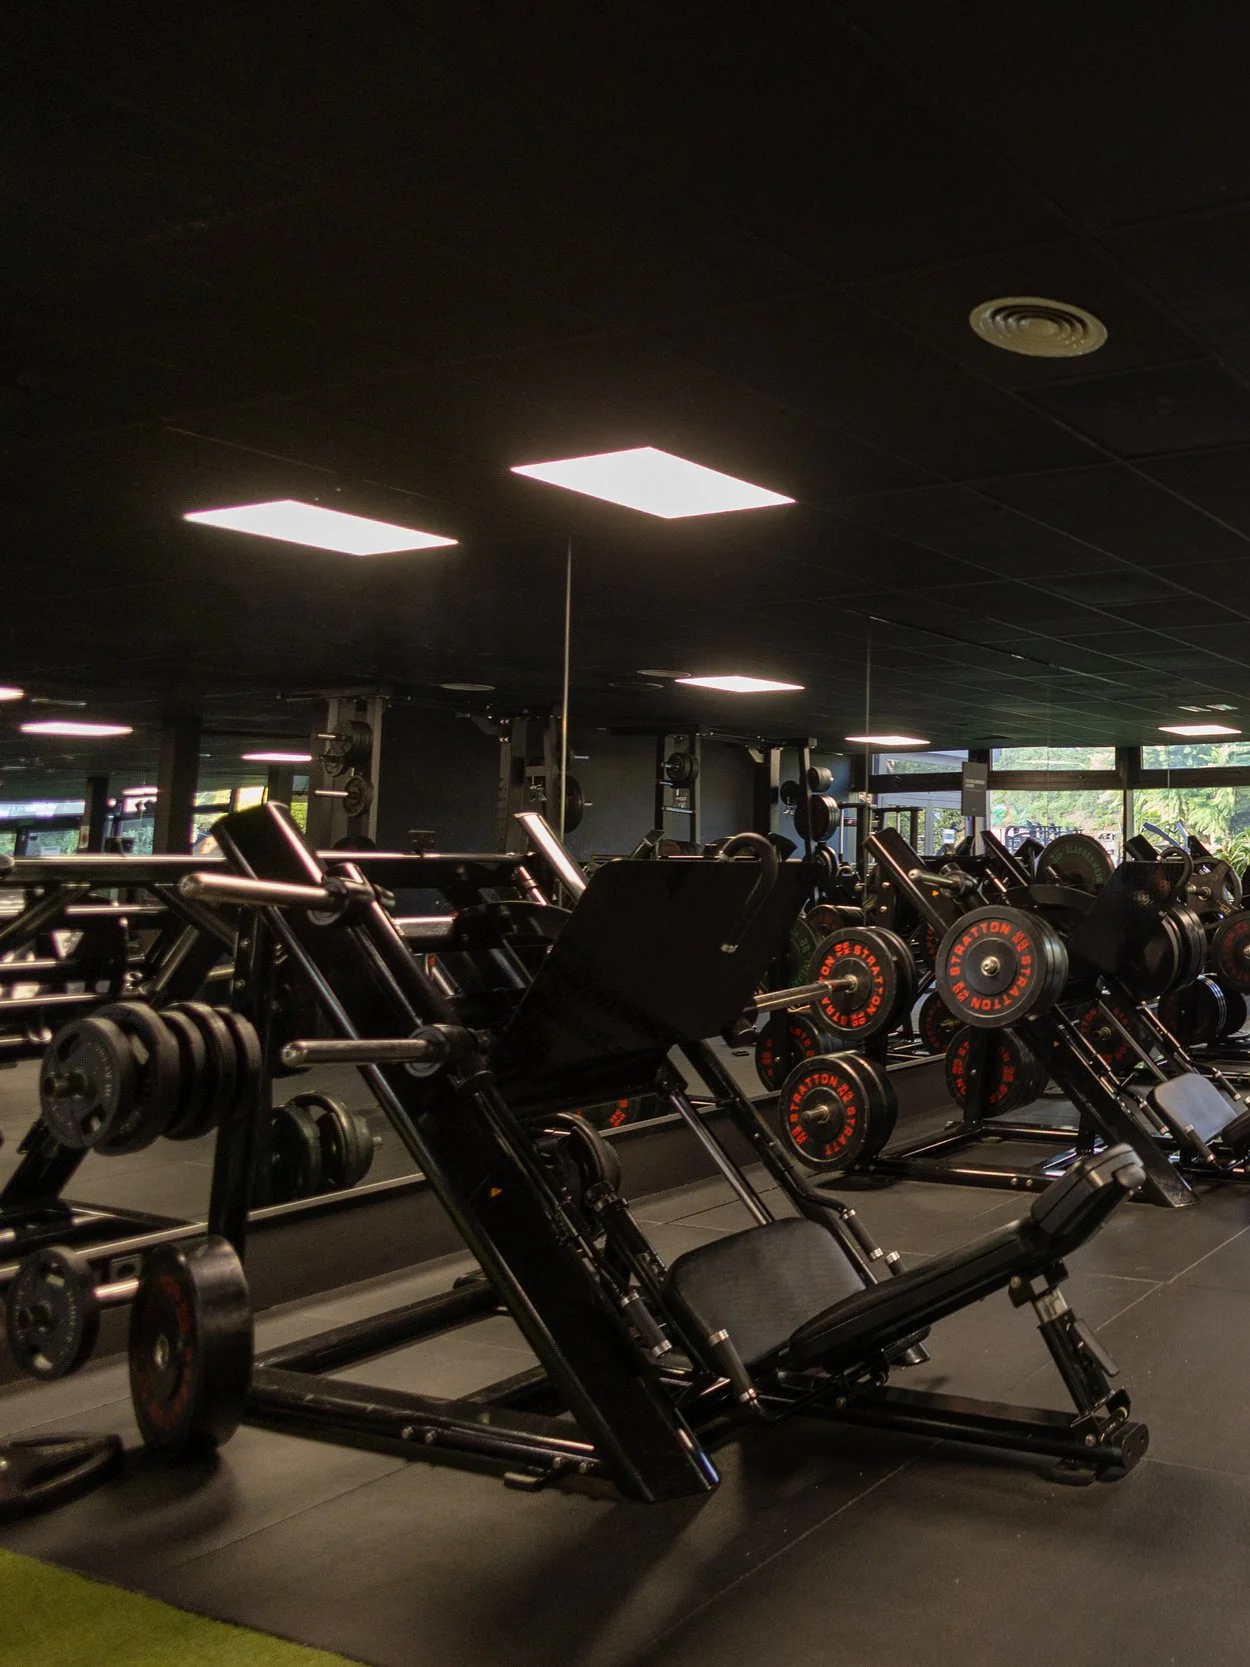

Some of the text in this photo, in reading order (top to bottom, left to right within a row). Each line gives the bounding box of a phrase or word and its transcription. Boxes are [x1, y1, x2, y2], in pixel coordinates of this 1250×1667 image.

[949, 921, 1012, 977] STRATTON
[853, 943, 885, 1017] STRATTON
[970, 955, 1032, 1011] STRATTON
[789, 1073, 839, 1123] STRATTON
